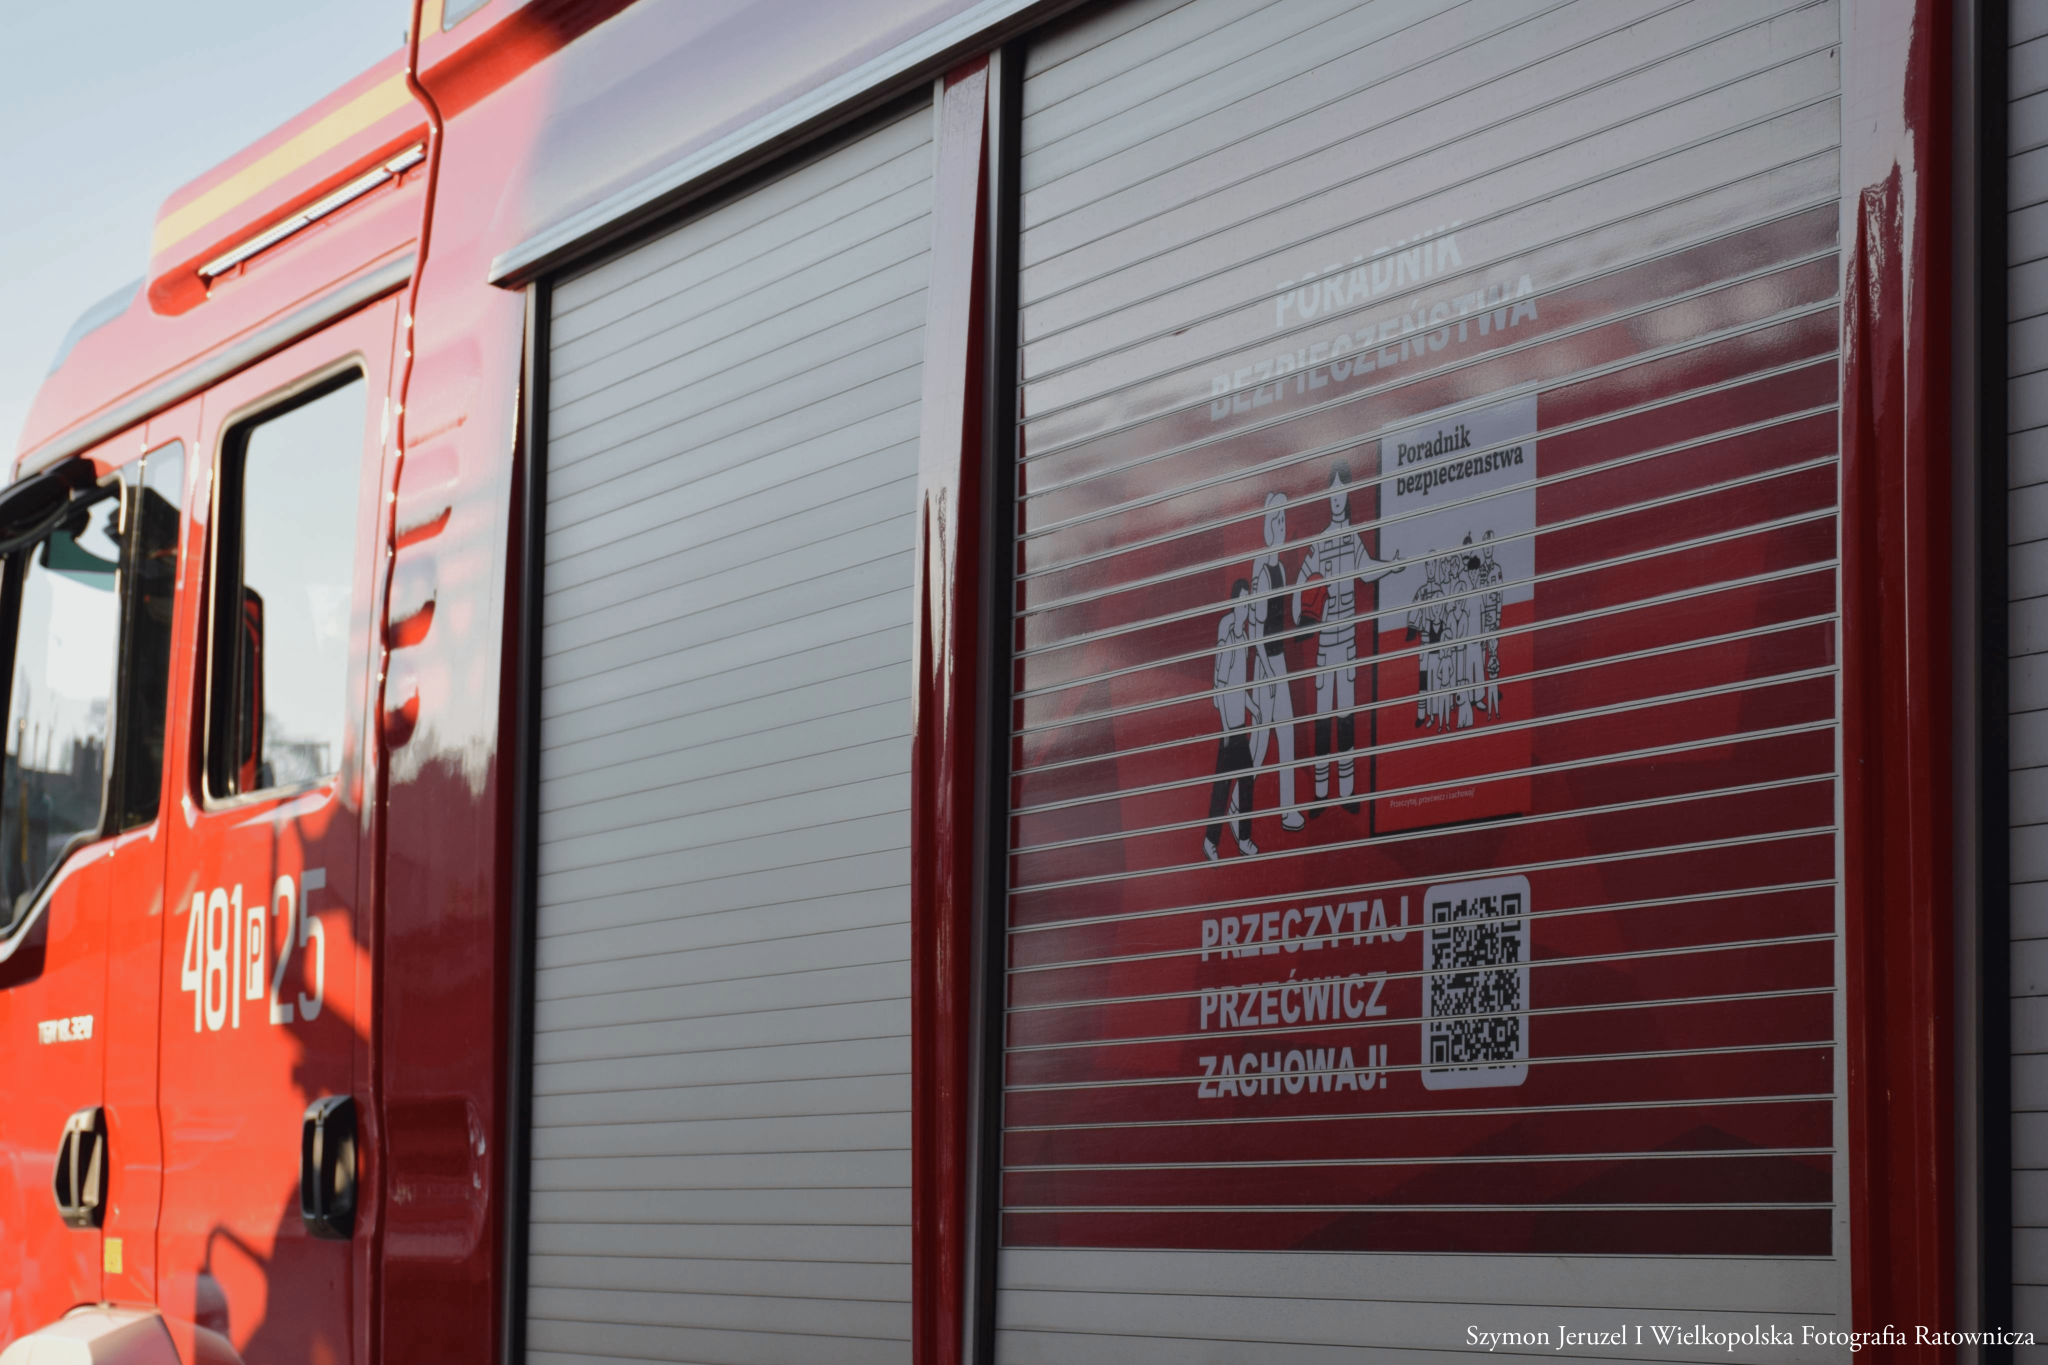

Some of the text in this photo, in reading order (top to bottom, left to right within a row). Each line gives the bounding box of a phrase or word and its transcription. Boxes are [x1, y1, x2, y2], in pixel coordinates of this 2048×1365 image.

[1276, 219, 1463, 328] PORADNIK
[1210, 274, 1538, 422] BEZPIECZEŃSTWA
[1397, 424, 1471, 466] Poradnik
[1201, 895, 1409, 962] PRZECZYTAJ
[1200, 969, 1388, 1030] PRZEĆWICZ
[1197, 1044, 1388, 1099] ZACHOWAJ!
